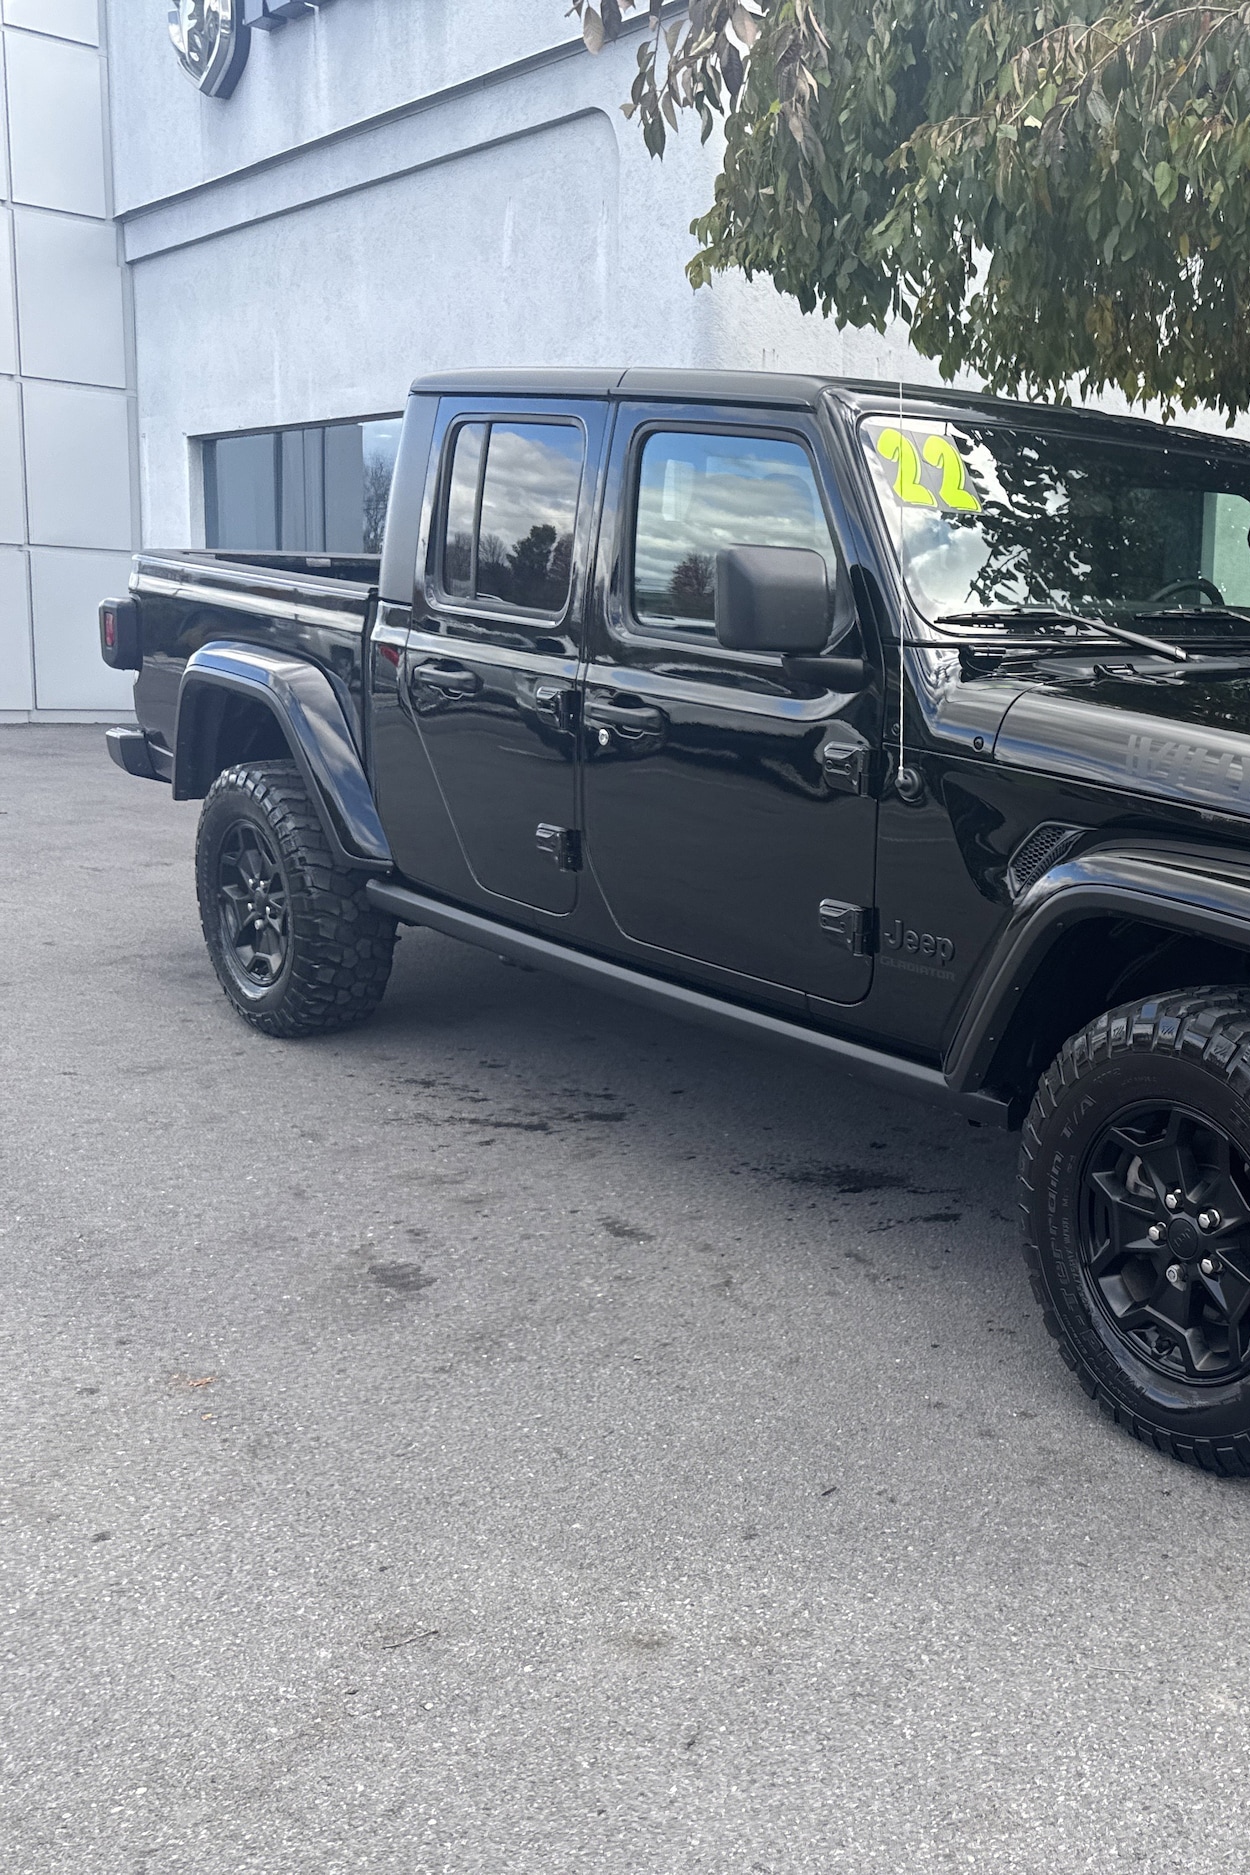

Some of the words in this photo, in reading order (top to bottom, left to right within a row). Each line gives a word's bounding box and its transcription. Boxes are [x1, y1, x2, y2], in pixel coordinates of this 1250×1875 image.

[877, 427, 981, 511] 22
[883, 918, 956, 967] Jeep
[880, 955, 955, 981] GLADIATOR
[1059, 1092, 1096, 1141] T/A
